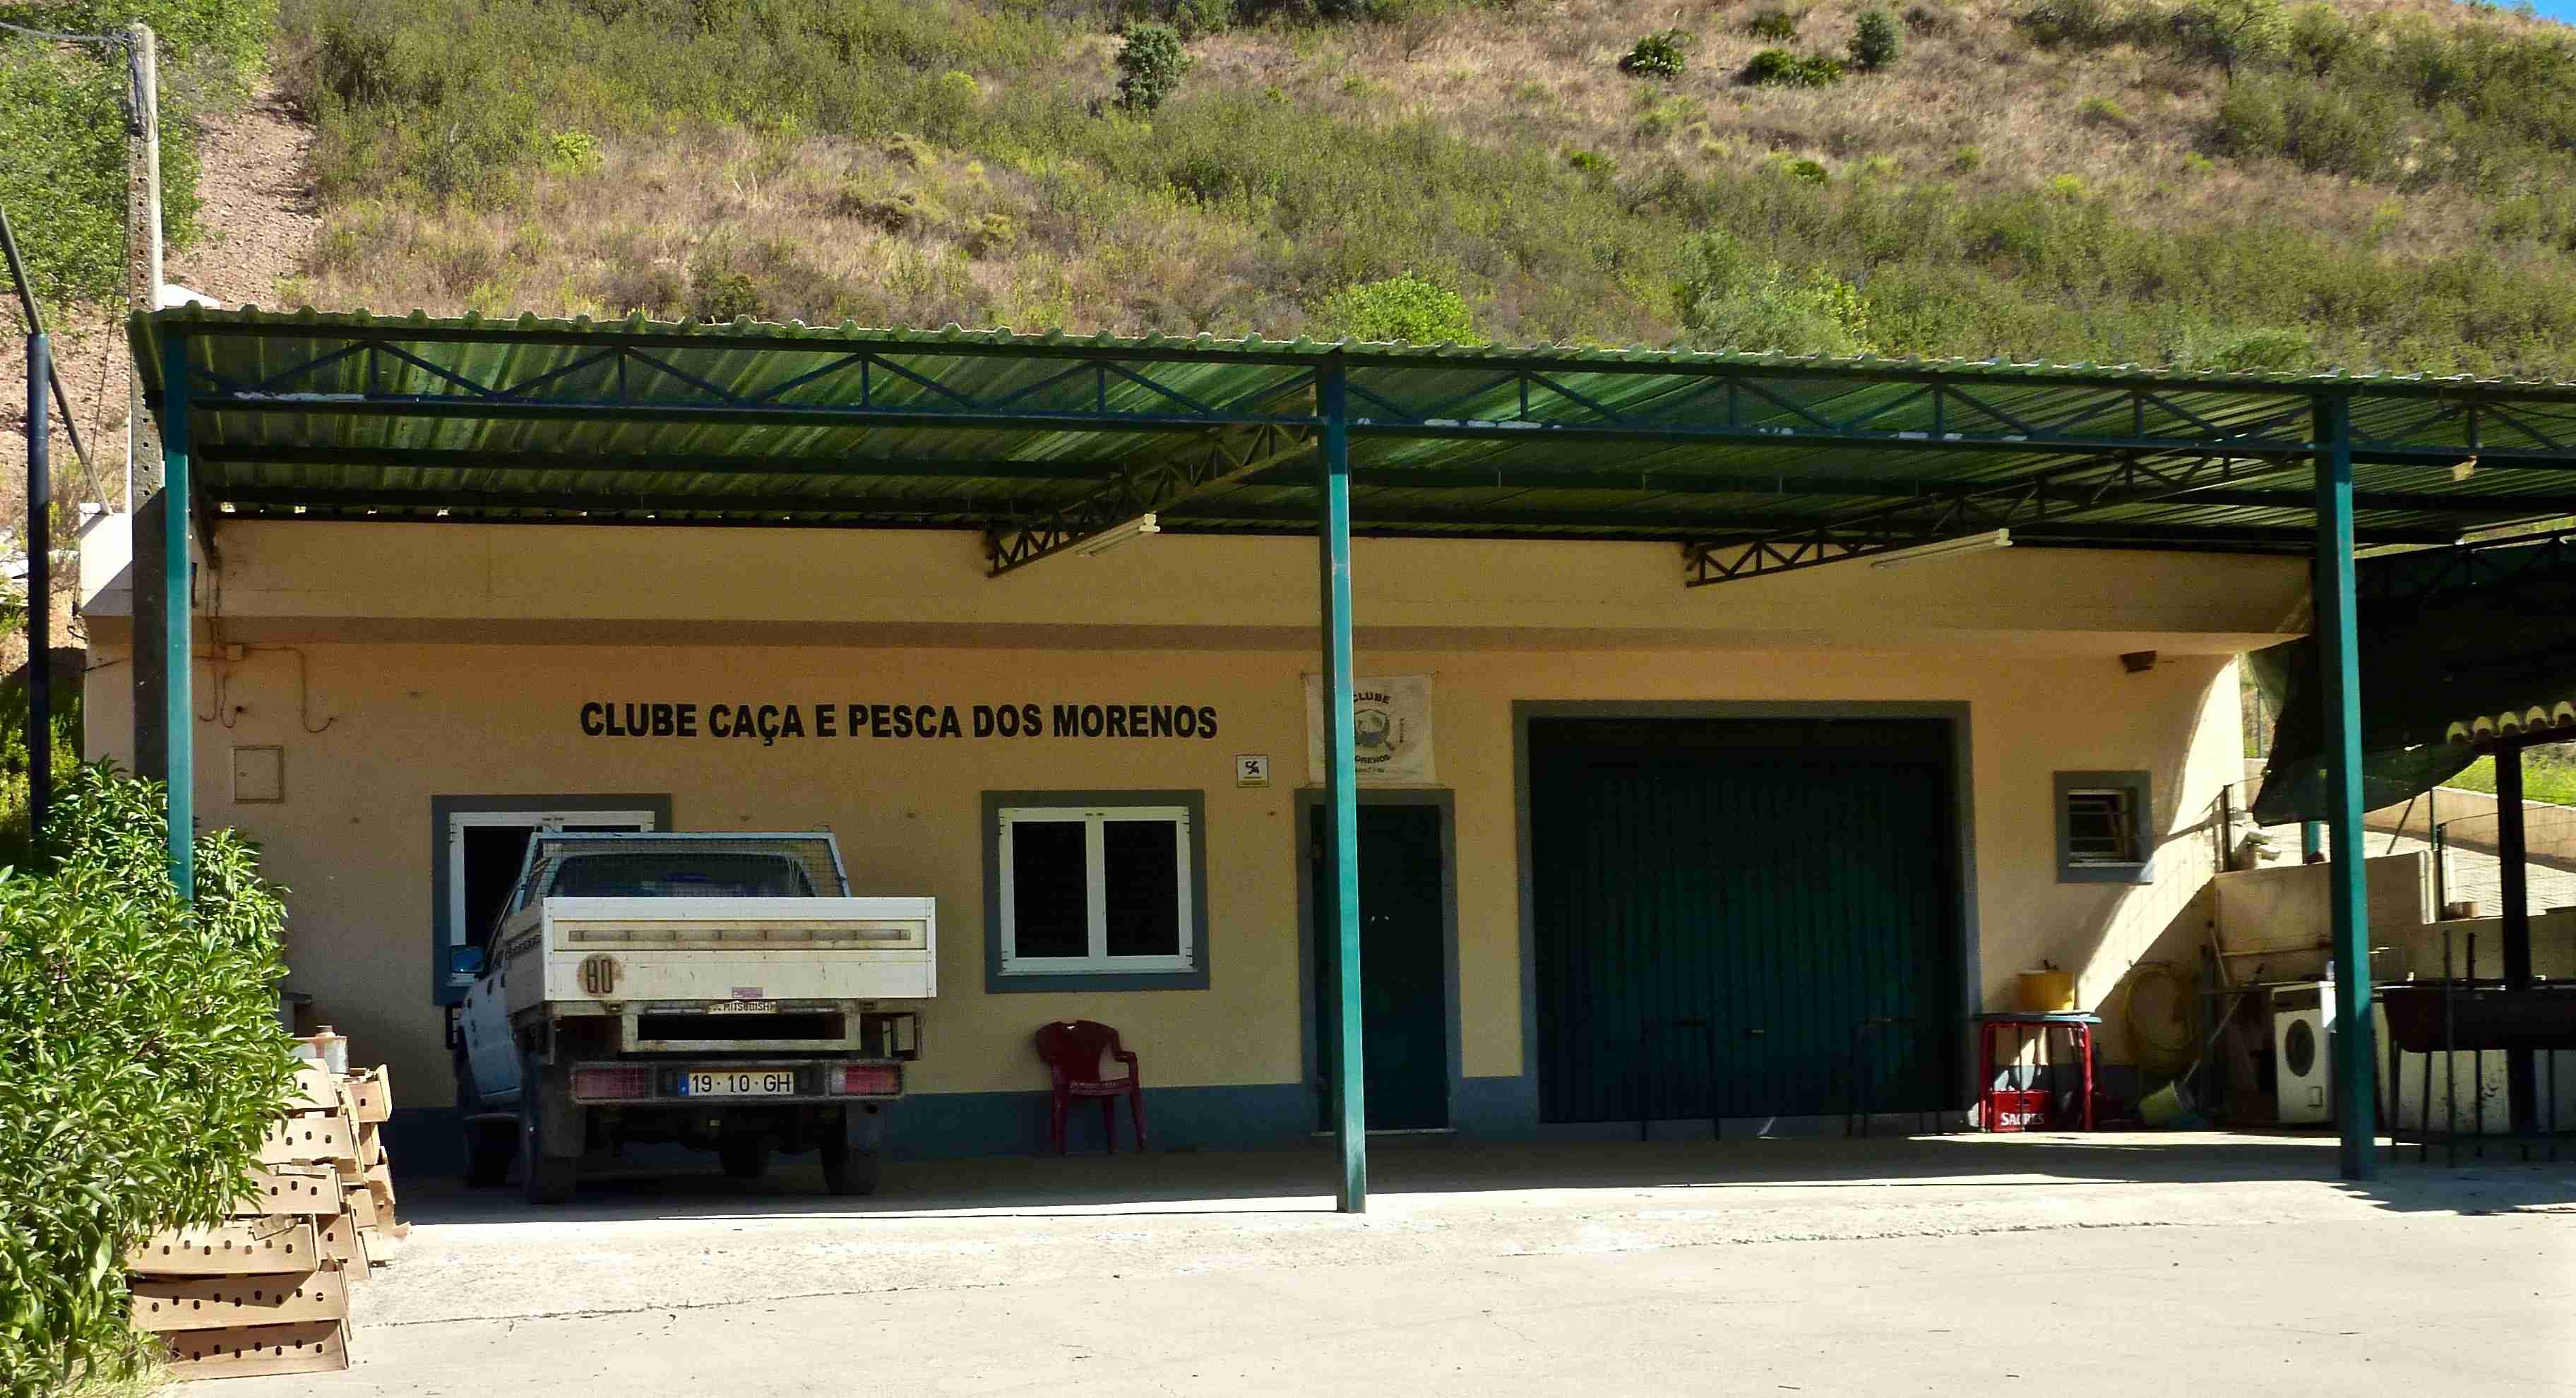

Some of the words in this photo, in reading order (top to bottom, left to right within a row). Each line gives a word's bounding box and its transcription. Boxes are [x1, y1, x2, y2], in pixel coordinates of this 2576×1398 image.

[580, 702, 697, 736] CLUBE
[708, 704, 806, 746] CAÇA
[816, 703, 836, 737] E
[848, 704, 962, 738] PESCA
[973, 703, 1043, 738] DOS
[1054, 705, 1218, 739] MORENOS
[1354, 753, 1390, 764] ORENOS
[587, 959, 613, 994] 80
